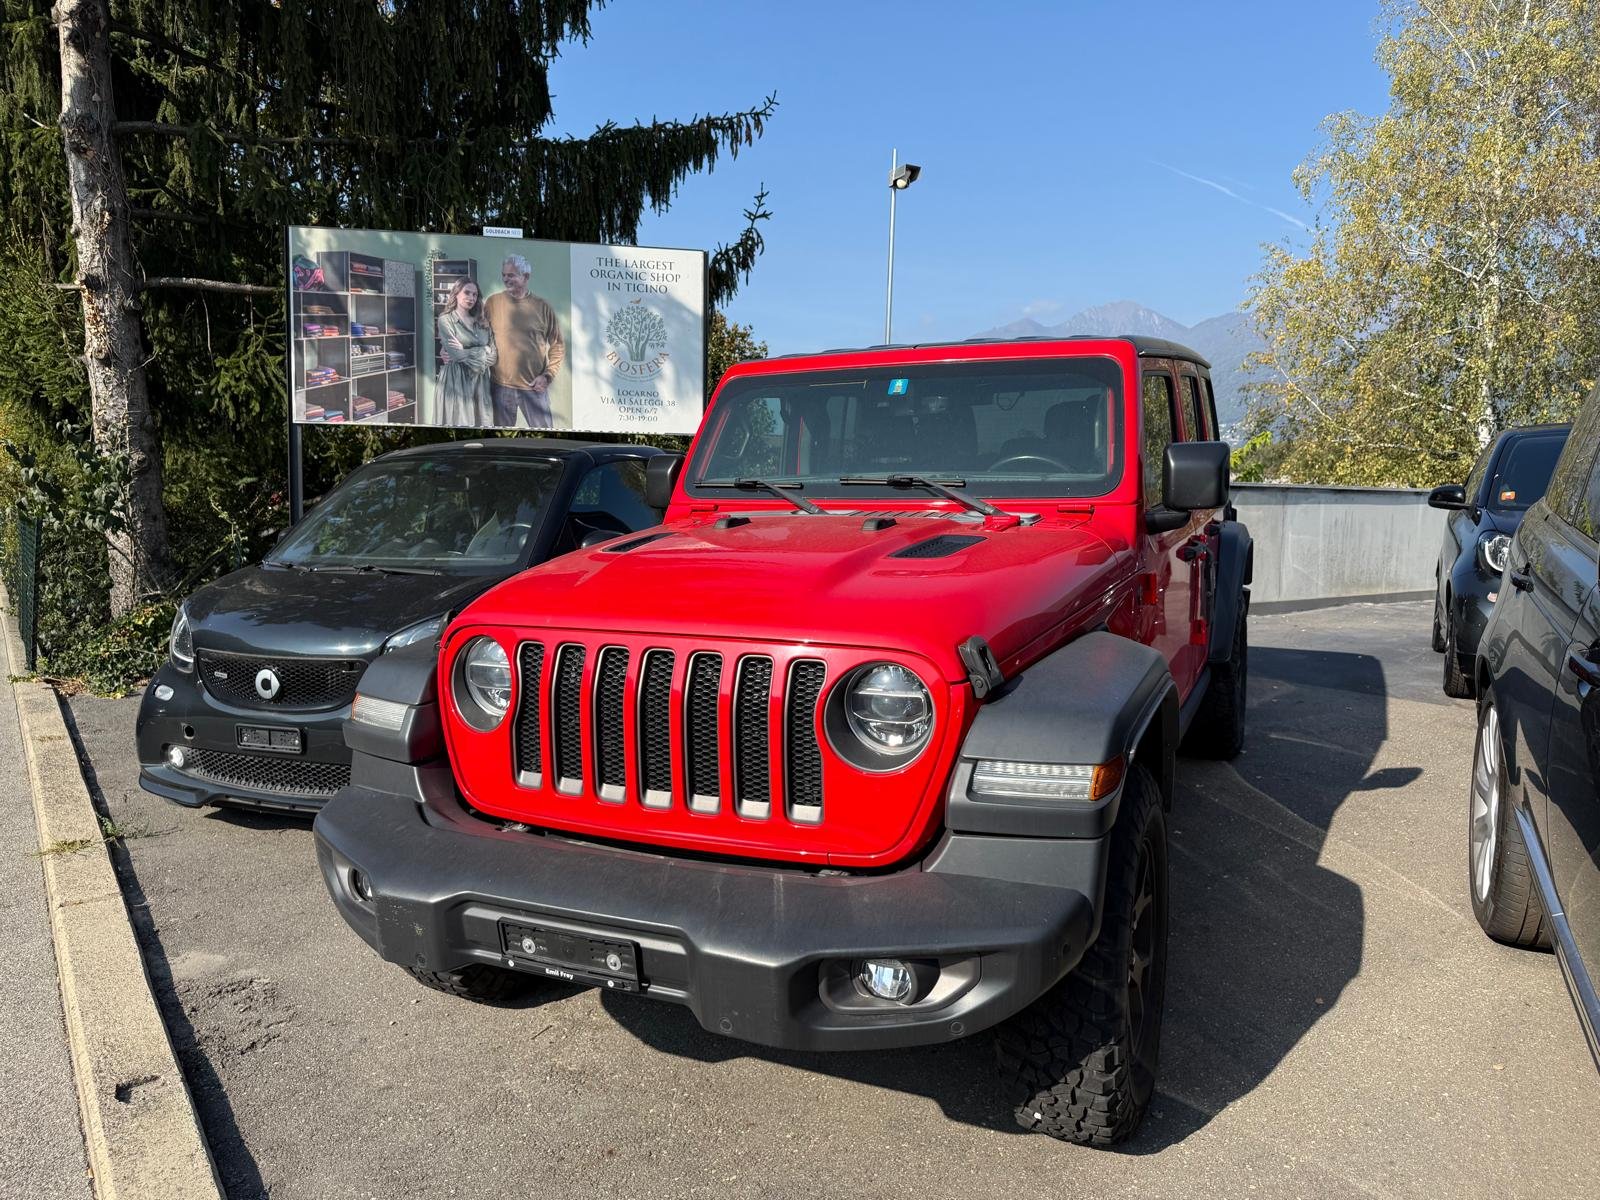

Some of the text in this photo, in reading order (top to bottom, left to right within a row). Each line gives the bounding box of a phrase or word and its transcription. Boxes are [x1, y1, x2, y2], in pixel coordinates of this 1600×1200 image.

[596, 257, 675, 271] THE LARGEST
[590, 268, 681, 283] ORGANIC SHOP
[607, 282, 668, 294] IN TICINO
[606, 351, 670, 376] BIOSFERA
[645, 407, 658, 415] 6/7
[619, 415, 658, 423] 7:30-19:00
[545, 967, 574, 980] Emil Frey
